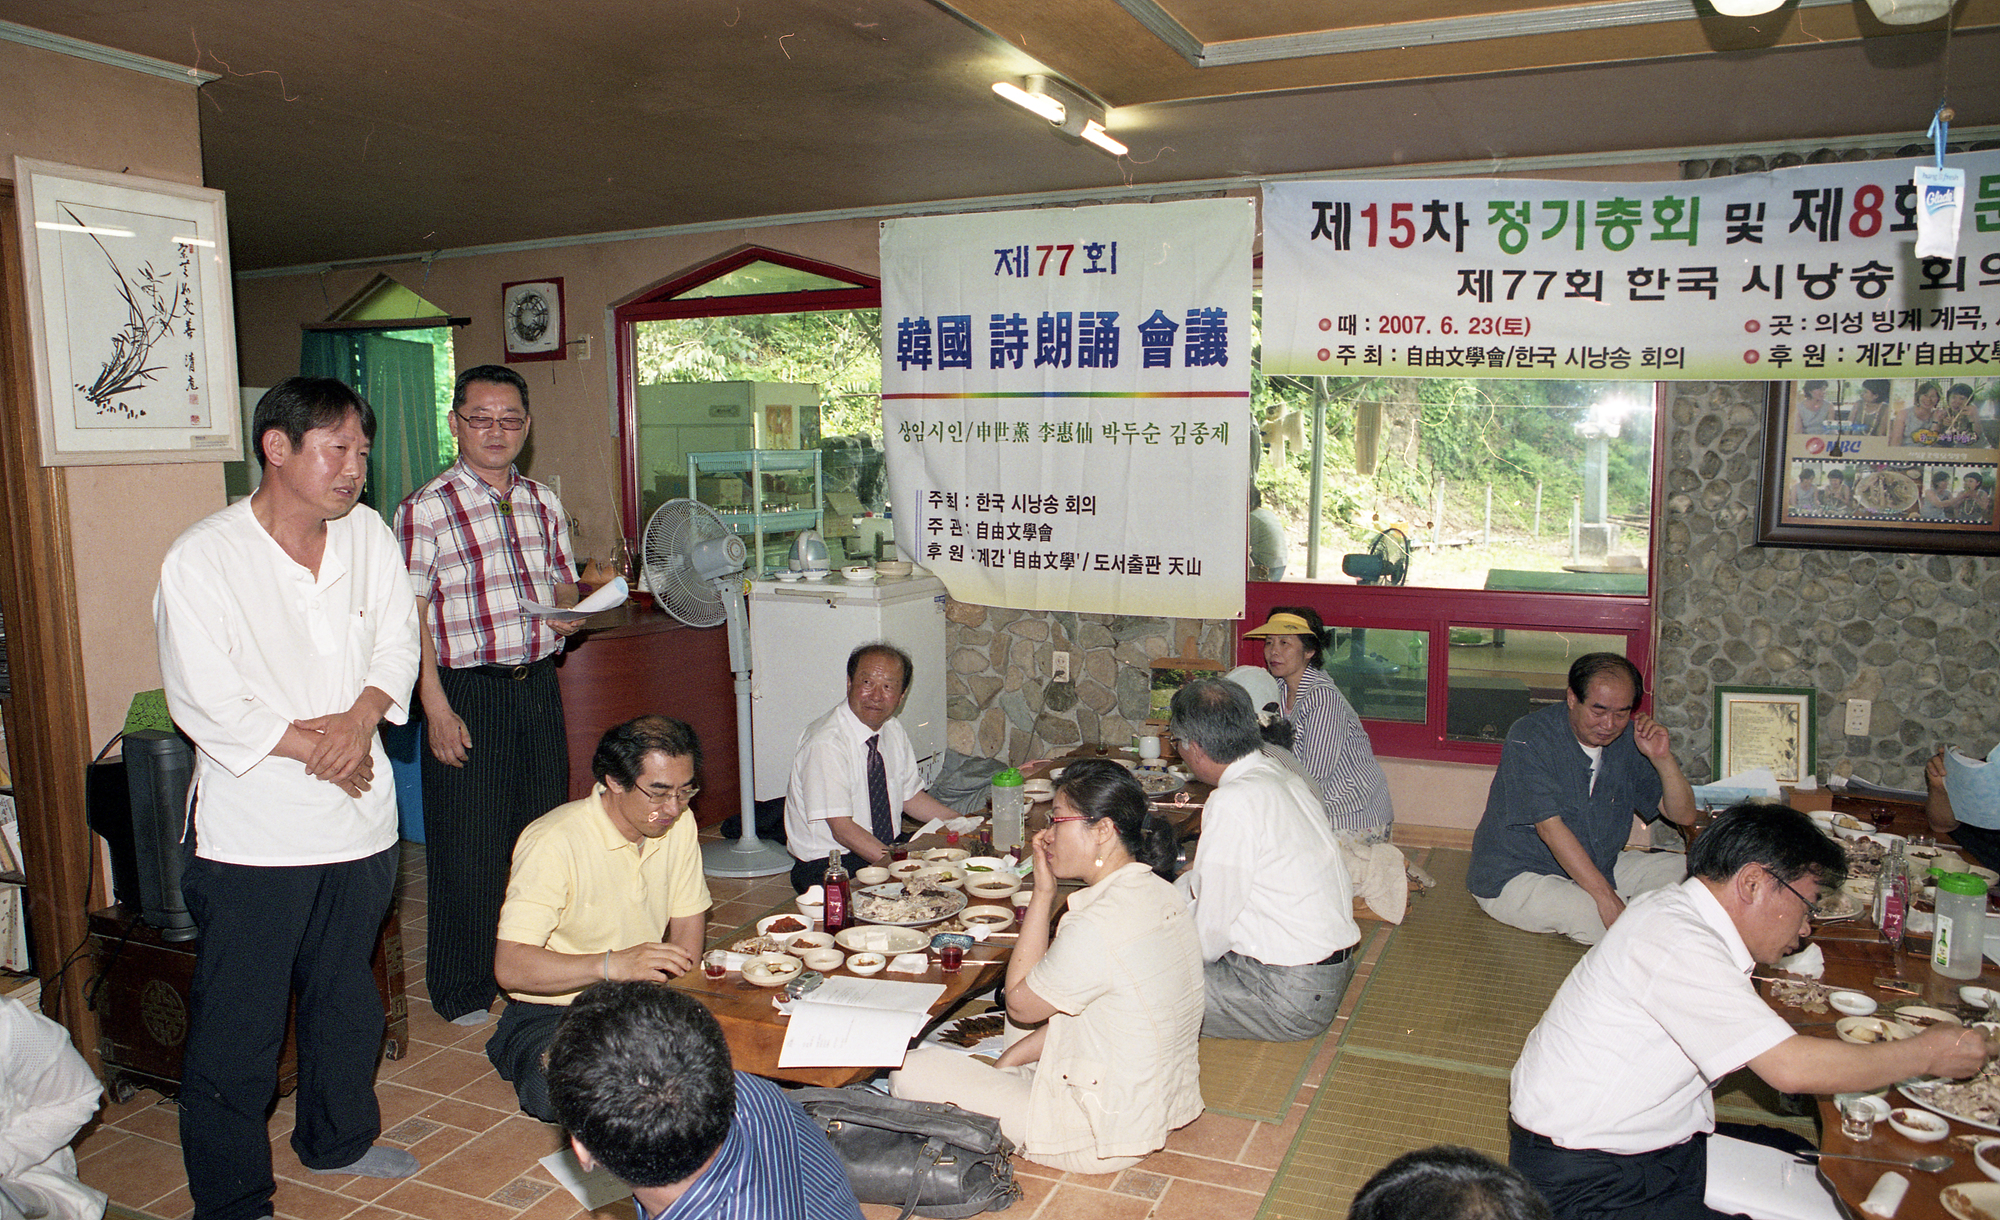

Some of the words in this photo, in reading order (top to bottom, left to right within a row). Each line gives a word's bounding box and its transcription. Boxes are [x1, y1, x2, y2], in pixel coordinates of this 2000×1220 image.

[1310, 199, 1470, 253] 제15차
[1487, 194, 1701, 256] 정기총회
[1725, 201, 1767, 245] 및
[994, 241, 1117, 278] 제77회
[1457, 268, 1604, 304] 제77회
[1626, 266, 1719, 302] 한국
[1741, 259, 1895, 301] 시낭송
[1337, 314, 1357, 336] 때
[1378, 315, 1431, 335] 2007.
[1440, 315, 1459, 335] 6.
[1468, 316, 1531, 338] 23(토)
[1769, 315, 1794, 337] 곳
[1814, 311, 1863, 335] 의성
[1872, 306, 1924, 333] 빙계
[896, 314, 973, 372] 韓國
[1137, 306, 1229, 369] 會議
[1564, 345, 1632, 370] 시낭송
[1640, 346, 1685, 370] 회의
[1102, 421, 1162, 446] 박두순
[1170, 421, 1229, 446] 김종제
[976, 492, 1006, 514] 한국
[1011, 493, 1060, 515] 시낭송
[1065, 494, 1096, 516] 회의
[976, 520, 1053, 543] 自由文學會
[1093, 553, 1162, 576] 도서출판
